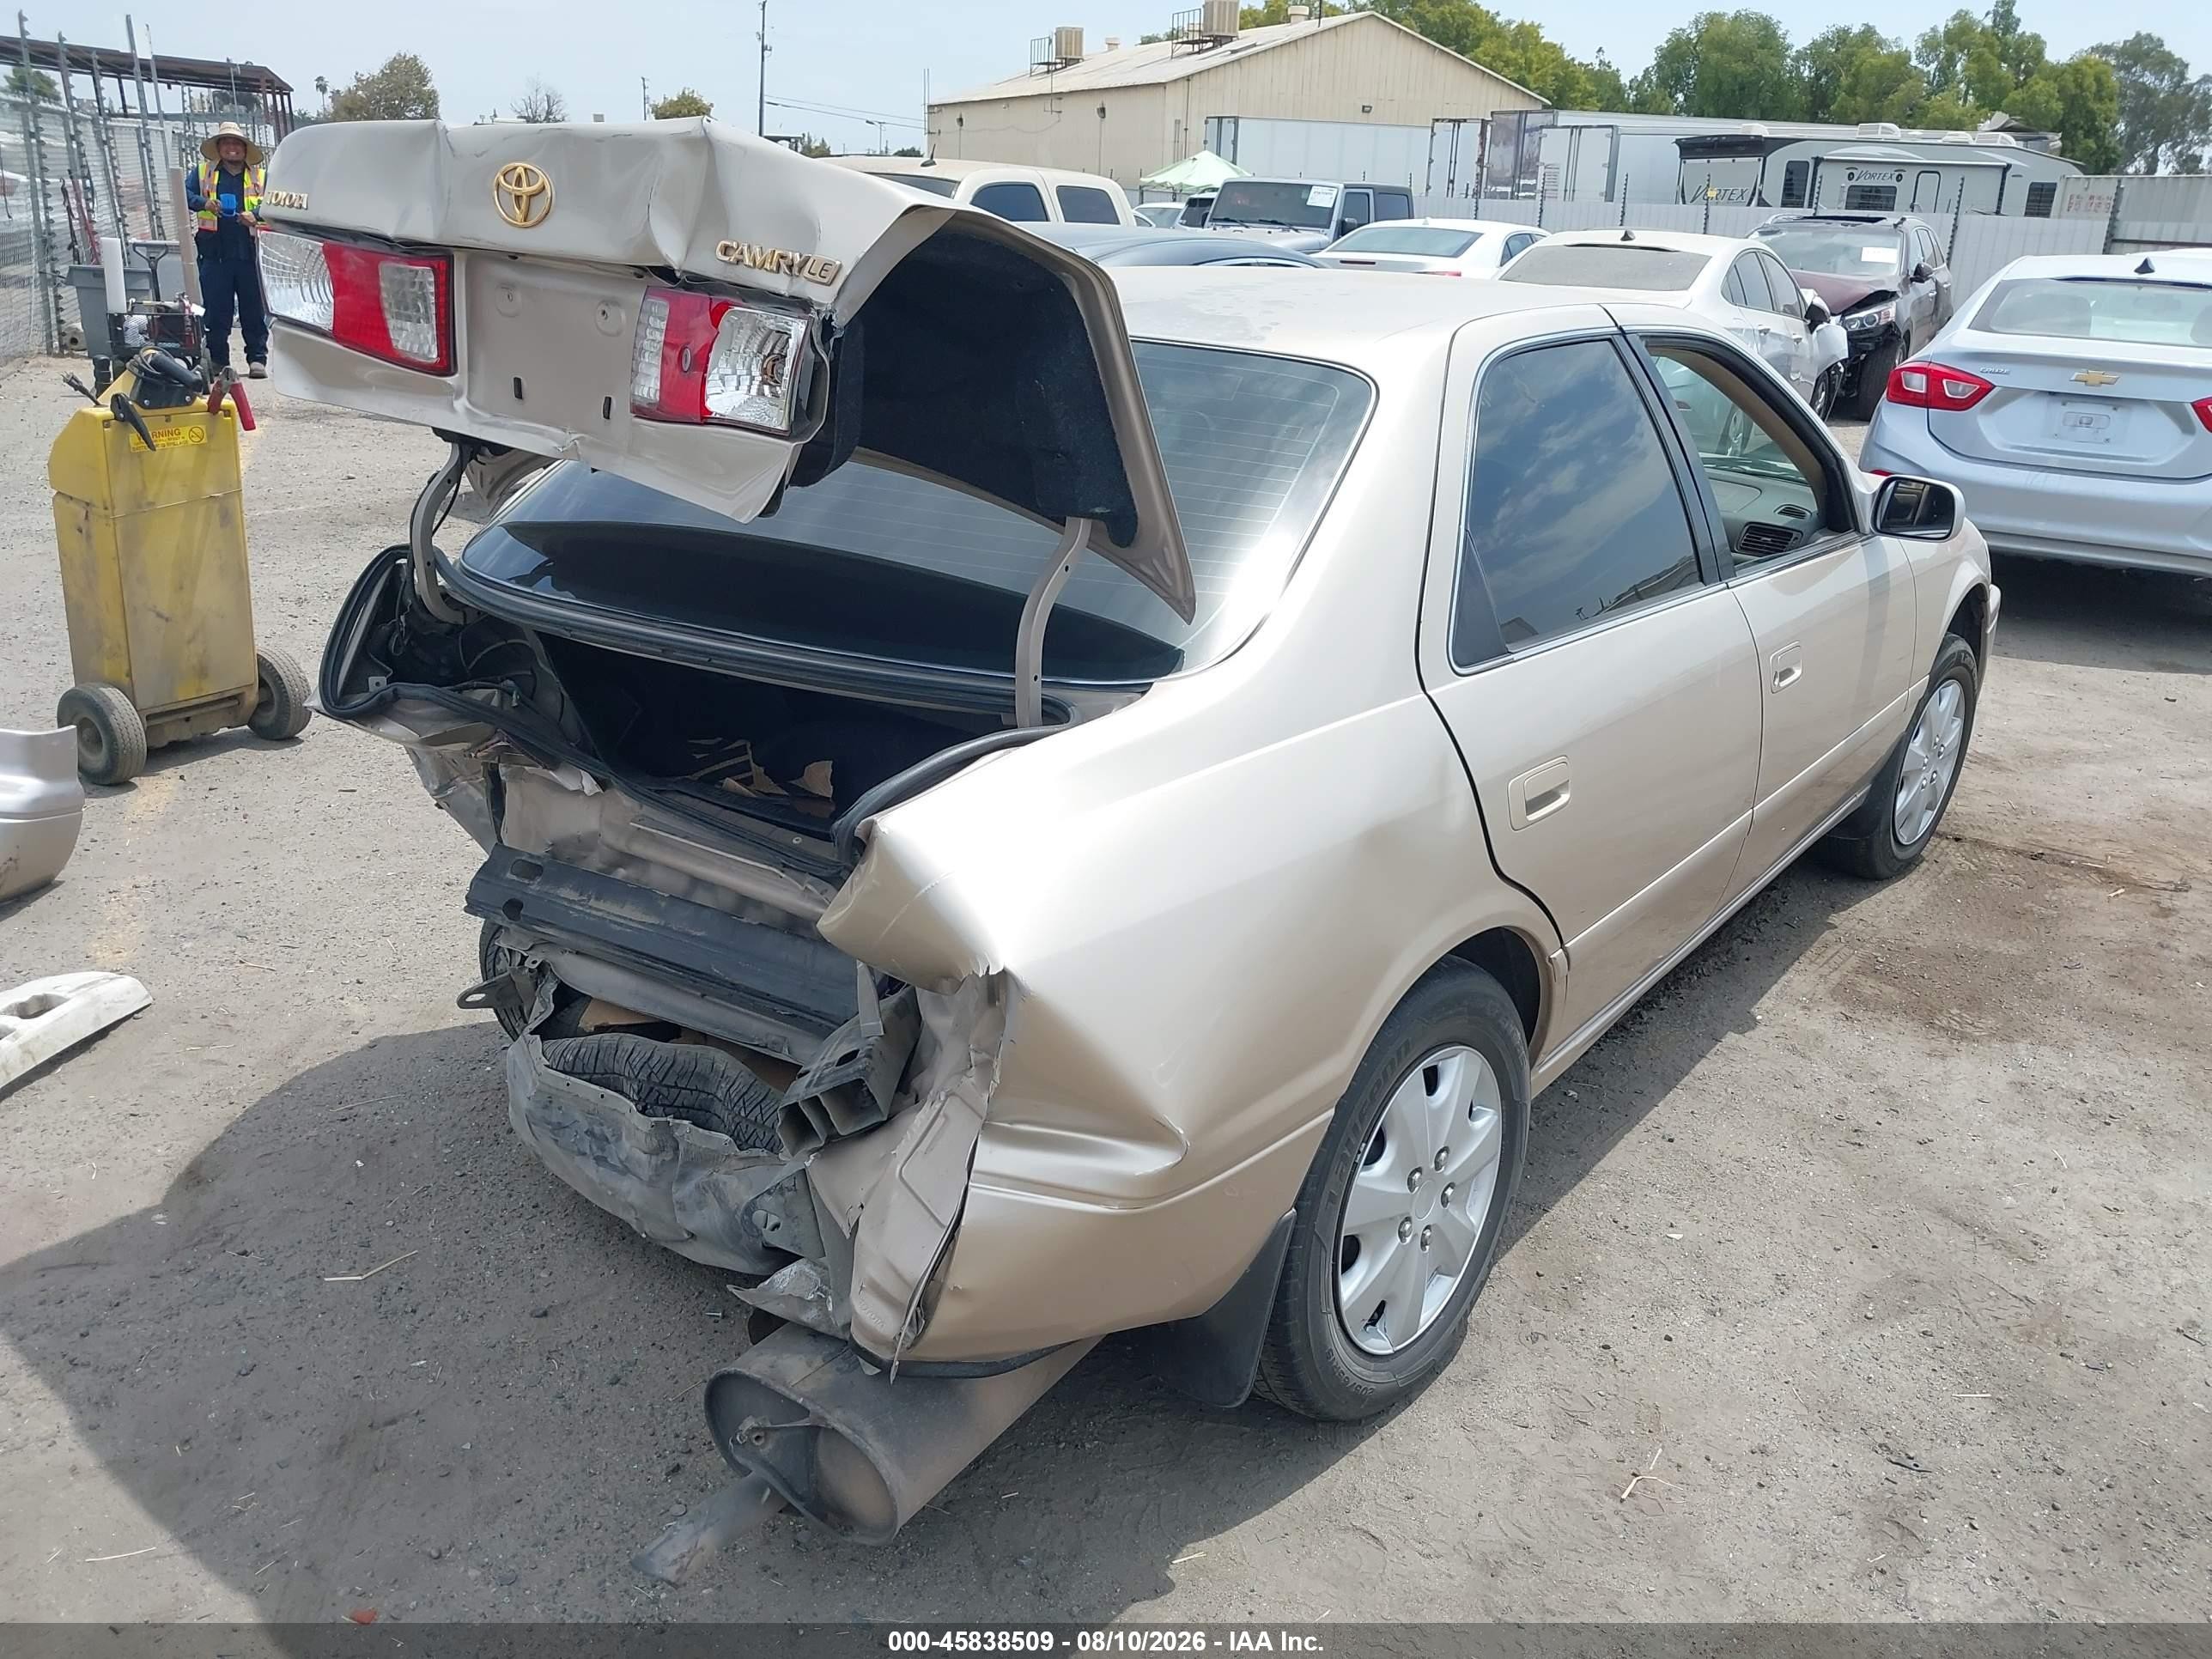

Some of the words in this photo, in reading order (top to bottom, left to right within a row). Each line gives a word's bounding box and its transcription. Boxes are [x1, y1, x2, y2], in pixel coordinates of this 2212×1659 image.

[1856, 170, 1894, 181] VORTEX
[266, 191, 308, 210] TOYOTA
[715, 240, 811, 276] CAMRY
[805, 257, 834, 281] LE
[137, 428, 182, 442] RNING
